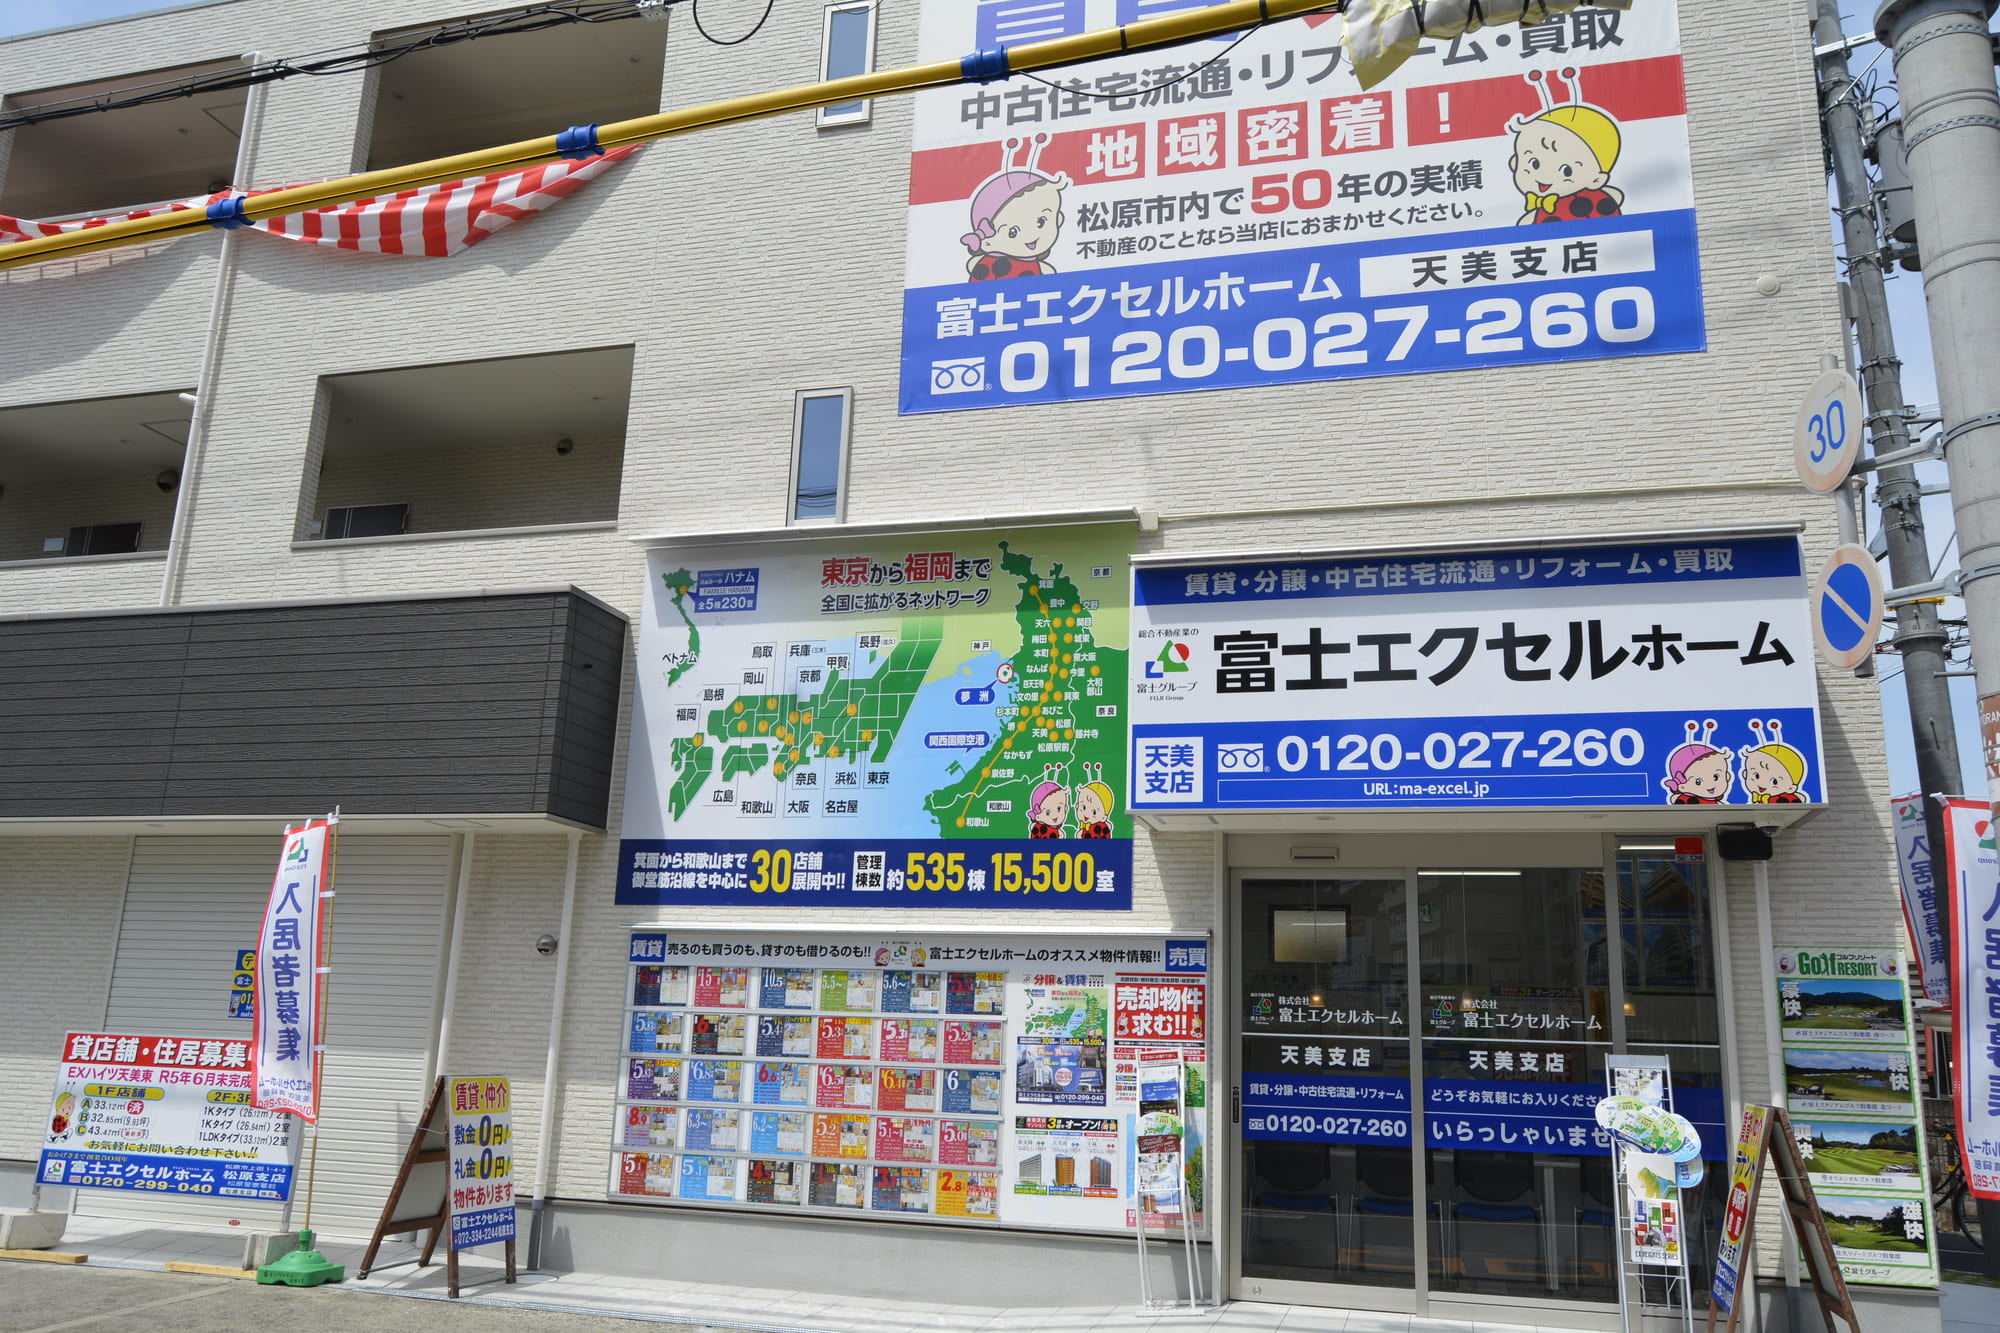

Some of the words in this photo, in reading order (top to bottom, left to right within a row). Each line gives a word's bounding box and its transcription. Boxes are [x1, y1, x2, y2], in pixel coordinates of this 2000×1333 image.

[961, 8, 1625, 131] 中古住宅流通・リフーム・買取
[1076, 159, 1485, 234] 松原市内で50年の実績
[1076, 201, 1485, 259] 不動産のことなら当店におまかせください。
[1411, 240, 1600, 289] 天美支店
[935, 263, 1343, 340] 富士エクセルホーム
[1001, 286, 1657, 393] 0120-027-260
[1808, 399, 1845, 463] 30
[724, 571, 755, 583] ハナム
[820, 551, 992, 587] 東京から福岡まで
[1184, 547, 1735, 597] 賃貸・分譲・中古住宅流通・リフォーム・買取
[820, 588, 991, 613] 全国に拡がるネットワーク
[858, 635, 881, 648] 長野
[1138, 628, 1199, 638] 総合不動産業の
[752, 646, 774, 658] 鳥取
[789, 645, 811, 658] 兵庫
[973, 641, 990, 651] 神戸
[1034, 649, 1049, 658] 本町
[662, 653, 697, 664] ベトナム
[827, 656, 848, 669] 甲賀
[1073, 653, 1096, 661] 東大阪
[1213, 619, 1796, 694] 富士エクセルホーム
[800, 669, 821, 683] 京都
[1026, 664, 1048, 673] なんば
[743, 671, 764, 685] 岡山
[703, 688, 725, 701] 島根
[1137, 681, 1197, 693] 富士グループ
[1016, 692, 1039, 701] 文の里
[676, 708, 697, 721] 福岡
[997, 707, 1018, 717] 杉本町
[1042, 706, 1063, 715] あびこ
[929, 735, 984, 746] 関西国際空港
[1003, 751, 1033, 759] なかもず
[1144, 744, 1195, 769] 天美
[1276, 728, 1645, 773] 0120-027-260
[796, 772, 817, 786] 奈良
[835, 772, 857, 785] 浜松
[867, 772, 890, 785] 東京
[1144, 770, 1194, 794] 支店
[713, 789, 734, 803] 広島
[1363, 781, 1490, 798] URL:ma-excel.jp
[740, 801, 773, 814] 和歌山
[788, 800, 809, 814] 大阪
[825, 799, 858, 814] 名古屋
[633, 852, 747, 870] 箕面から和歌山まで
[793, 852, 823, 871] 店舗
[856, 856, 881, 870] 管理
[750, 848, 792, 893] 30
[886, 852, 986, 892] 約535棟
[991, 852, 1115, 895] 15,500室
[631, 872, 747, 889] 御堂筋沿線を中心に
[791, 872, 846, 891] 展開中!!
[855, 871, 881, 888] 棟数
[631, 939, 663, 958] 賃貸
[667, 942, 872, 958] 売るのも買うのも、貸すのも借りるのも!!
[929, 946, 1161, 963] 富士エクセルホームのオススメ物件情報!!
[1168, 946, 1206, 967] 売買
[1837, 962, 1878, 976] RESORT
[1116, 986, 1203, 1012] 売却物件
[1278, 996, 1310, 1005] 株式会社
[1463, 1000, 1499, 1010] 株式会社
[1131, 1012, 1187, 1036] 求む!!
[1279, 1007, 1403, 1025] 富士エクセルホーム
[1463, 1012, 1602, 1031] 富士エクセルホーム
[71, 1035, 252, 1069] 貸店舗・住居募集
[1280, 1045, 1371, 1067] 天美支店
[1469, 1050, 1565, 1073] 天美支店
[67, 1066, 152, 1083] EXハイツ天美東
[97, 1085, 146, 1098] 1F店舗
[455, 1081, 508, 1112] 賃貸・仲介
[1250, 1083, 1405, 1100] 賃貸・分譲・中古住宅流通・リフォーム
[1431, 1088, 1603, 1108] どうぞお気軽にお入りくださ
[454, 1115, 510, 1147] 敷金0円!
[1266, 1114, 1407, 1138] 0120-027-260
[1432, 1120, 1611, 1148] いらっしゃいませ
[88, 1140, 258, 1159] お気軽にお問い合わせ下さい!!
[70, 1160, 215, 1183] 富士エクセルホーム
[454, 1148, 511, 1180] 礼金0円!
[82, 1175, 213, 1194] 0120-299-040
[222, 1170, 287, 1183] 松原支店
[453, 1182, 513, 1209] 物件あります
